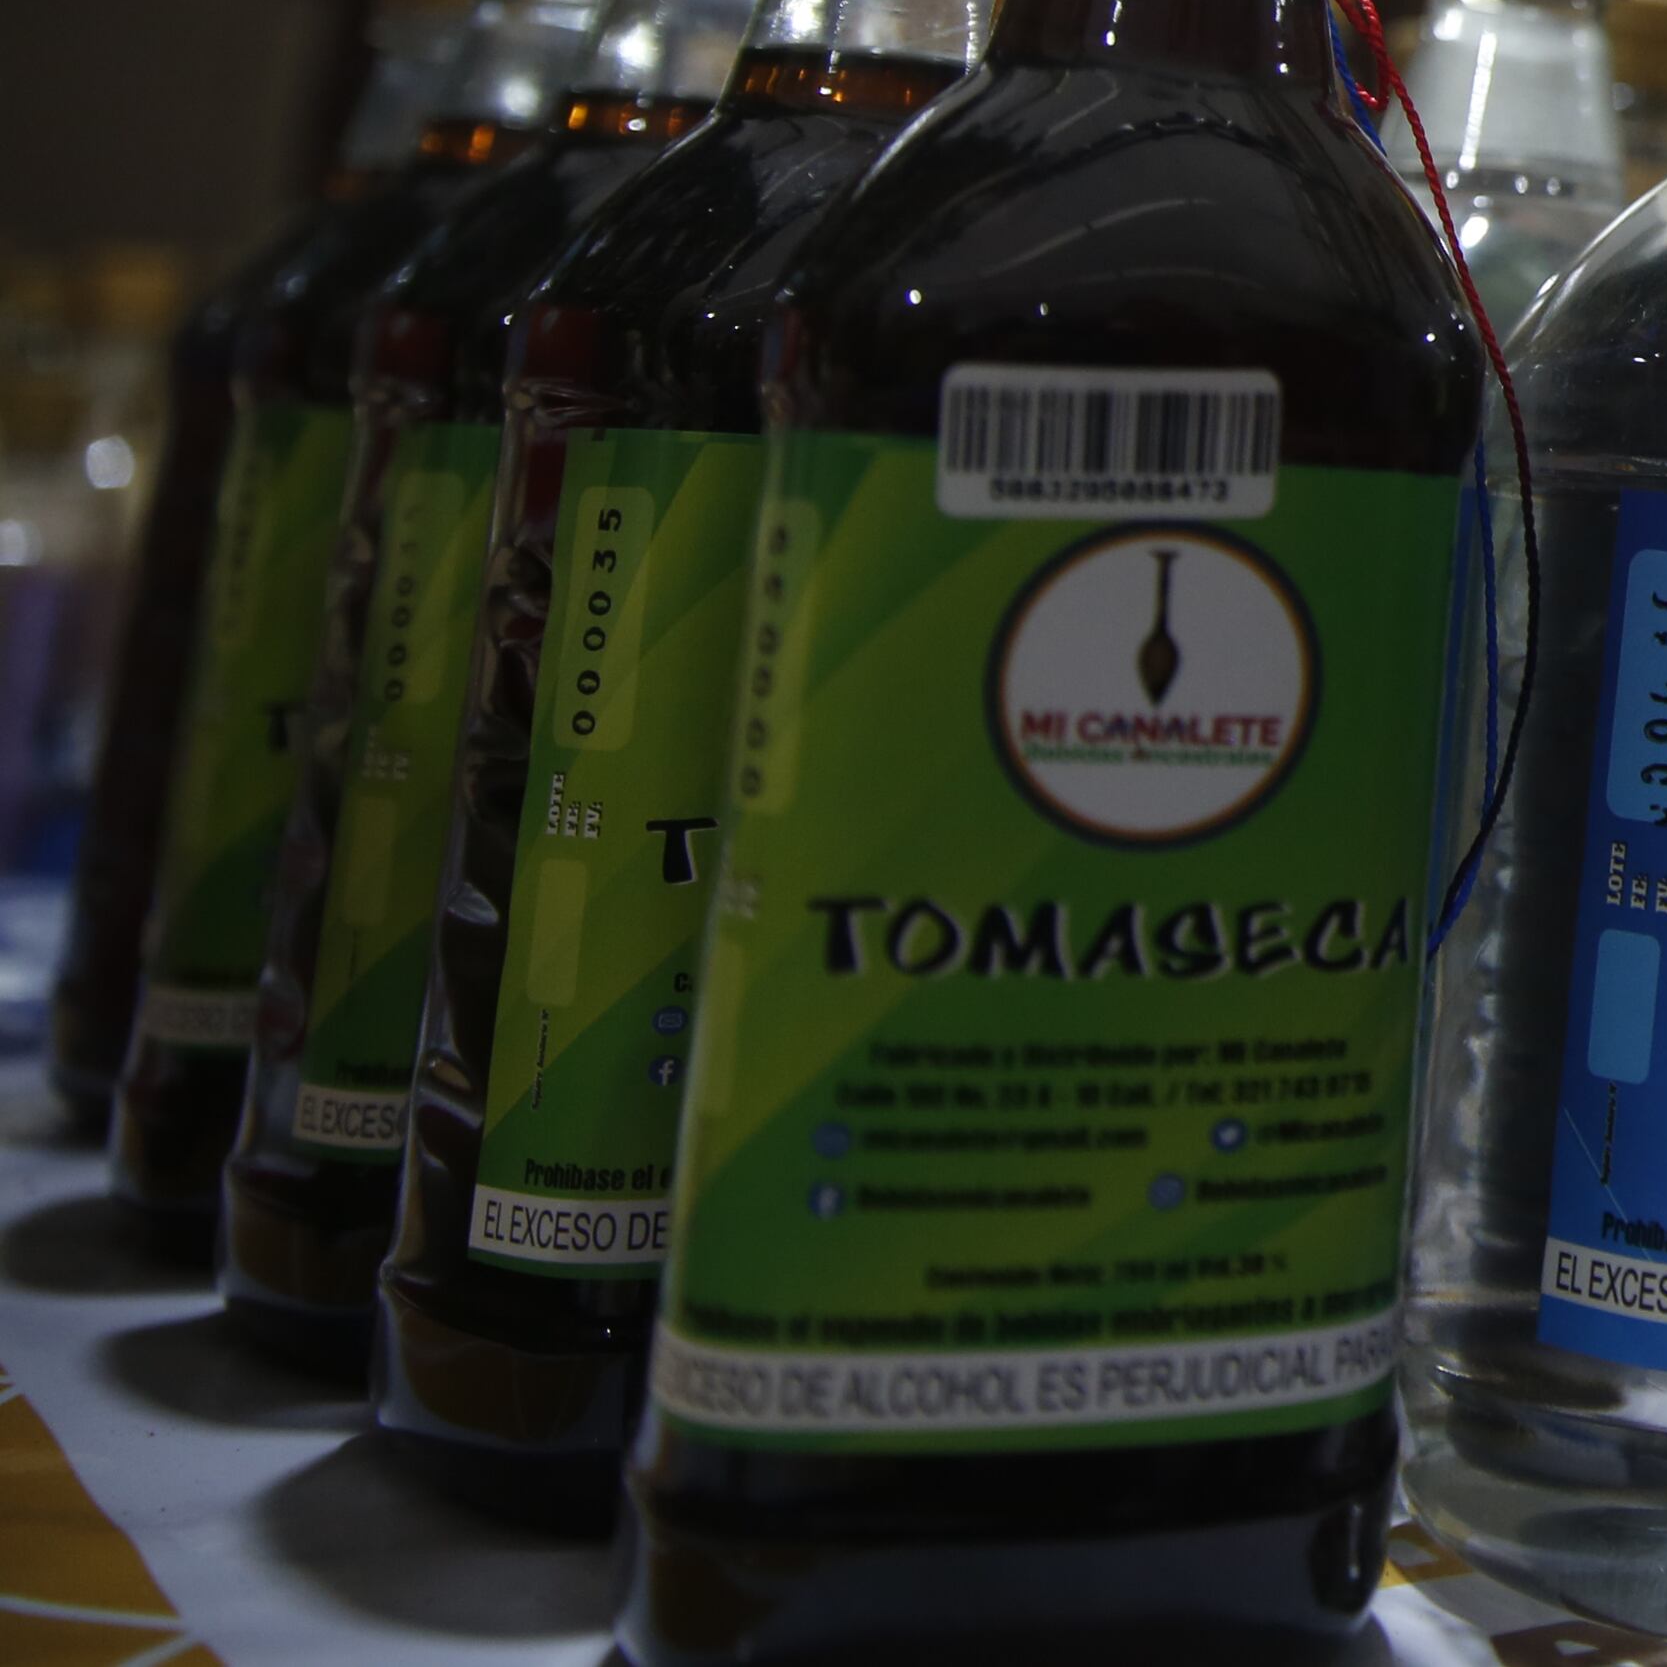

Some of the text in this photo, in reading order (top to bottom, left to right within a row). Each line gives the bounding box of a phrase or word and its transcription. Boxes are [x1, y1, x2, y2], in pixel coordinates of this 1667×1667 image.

[571, 507, 623, 736] 000035
[1022, 711, 1282, 746] MI CANALETE
[1606, 841, 1628, 907] LOTE
[808, 896, 1408, 982] TOMASECA
[321, 1098, 404, 1140] EXCES
[632, 1163, 654, 1191] el
[483, 1199, 505, 1243] EL
[510, 1205, 617, 1254] EXCESO
[1555, 1252, 1584, 1295] EL
[779, 1363, 835, 1420] DE
[840, 1355, 1024, 1420] ALCOHOL
[1036, 1360, 1086, 1412] ES
[1099, 1340, 1326, 1406] PERJUDICIAL
